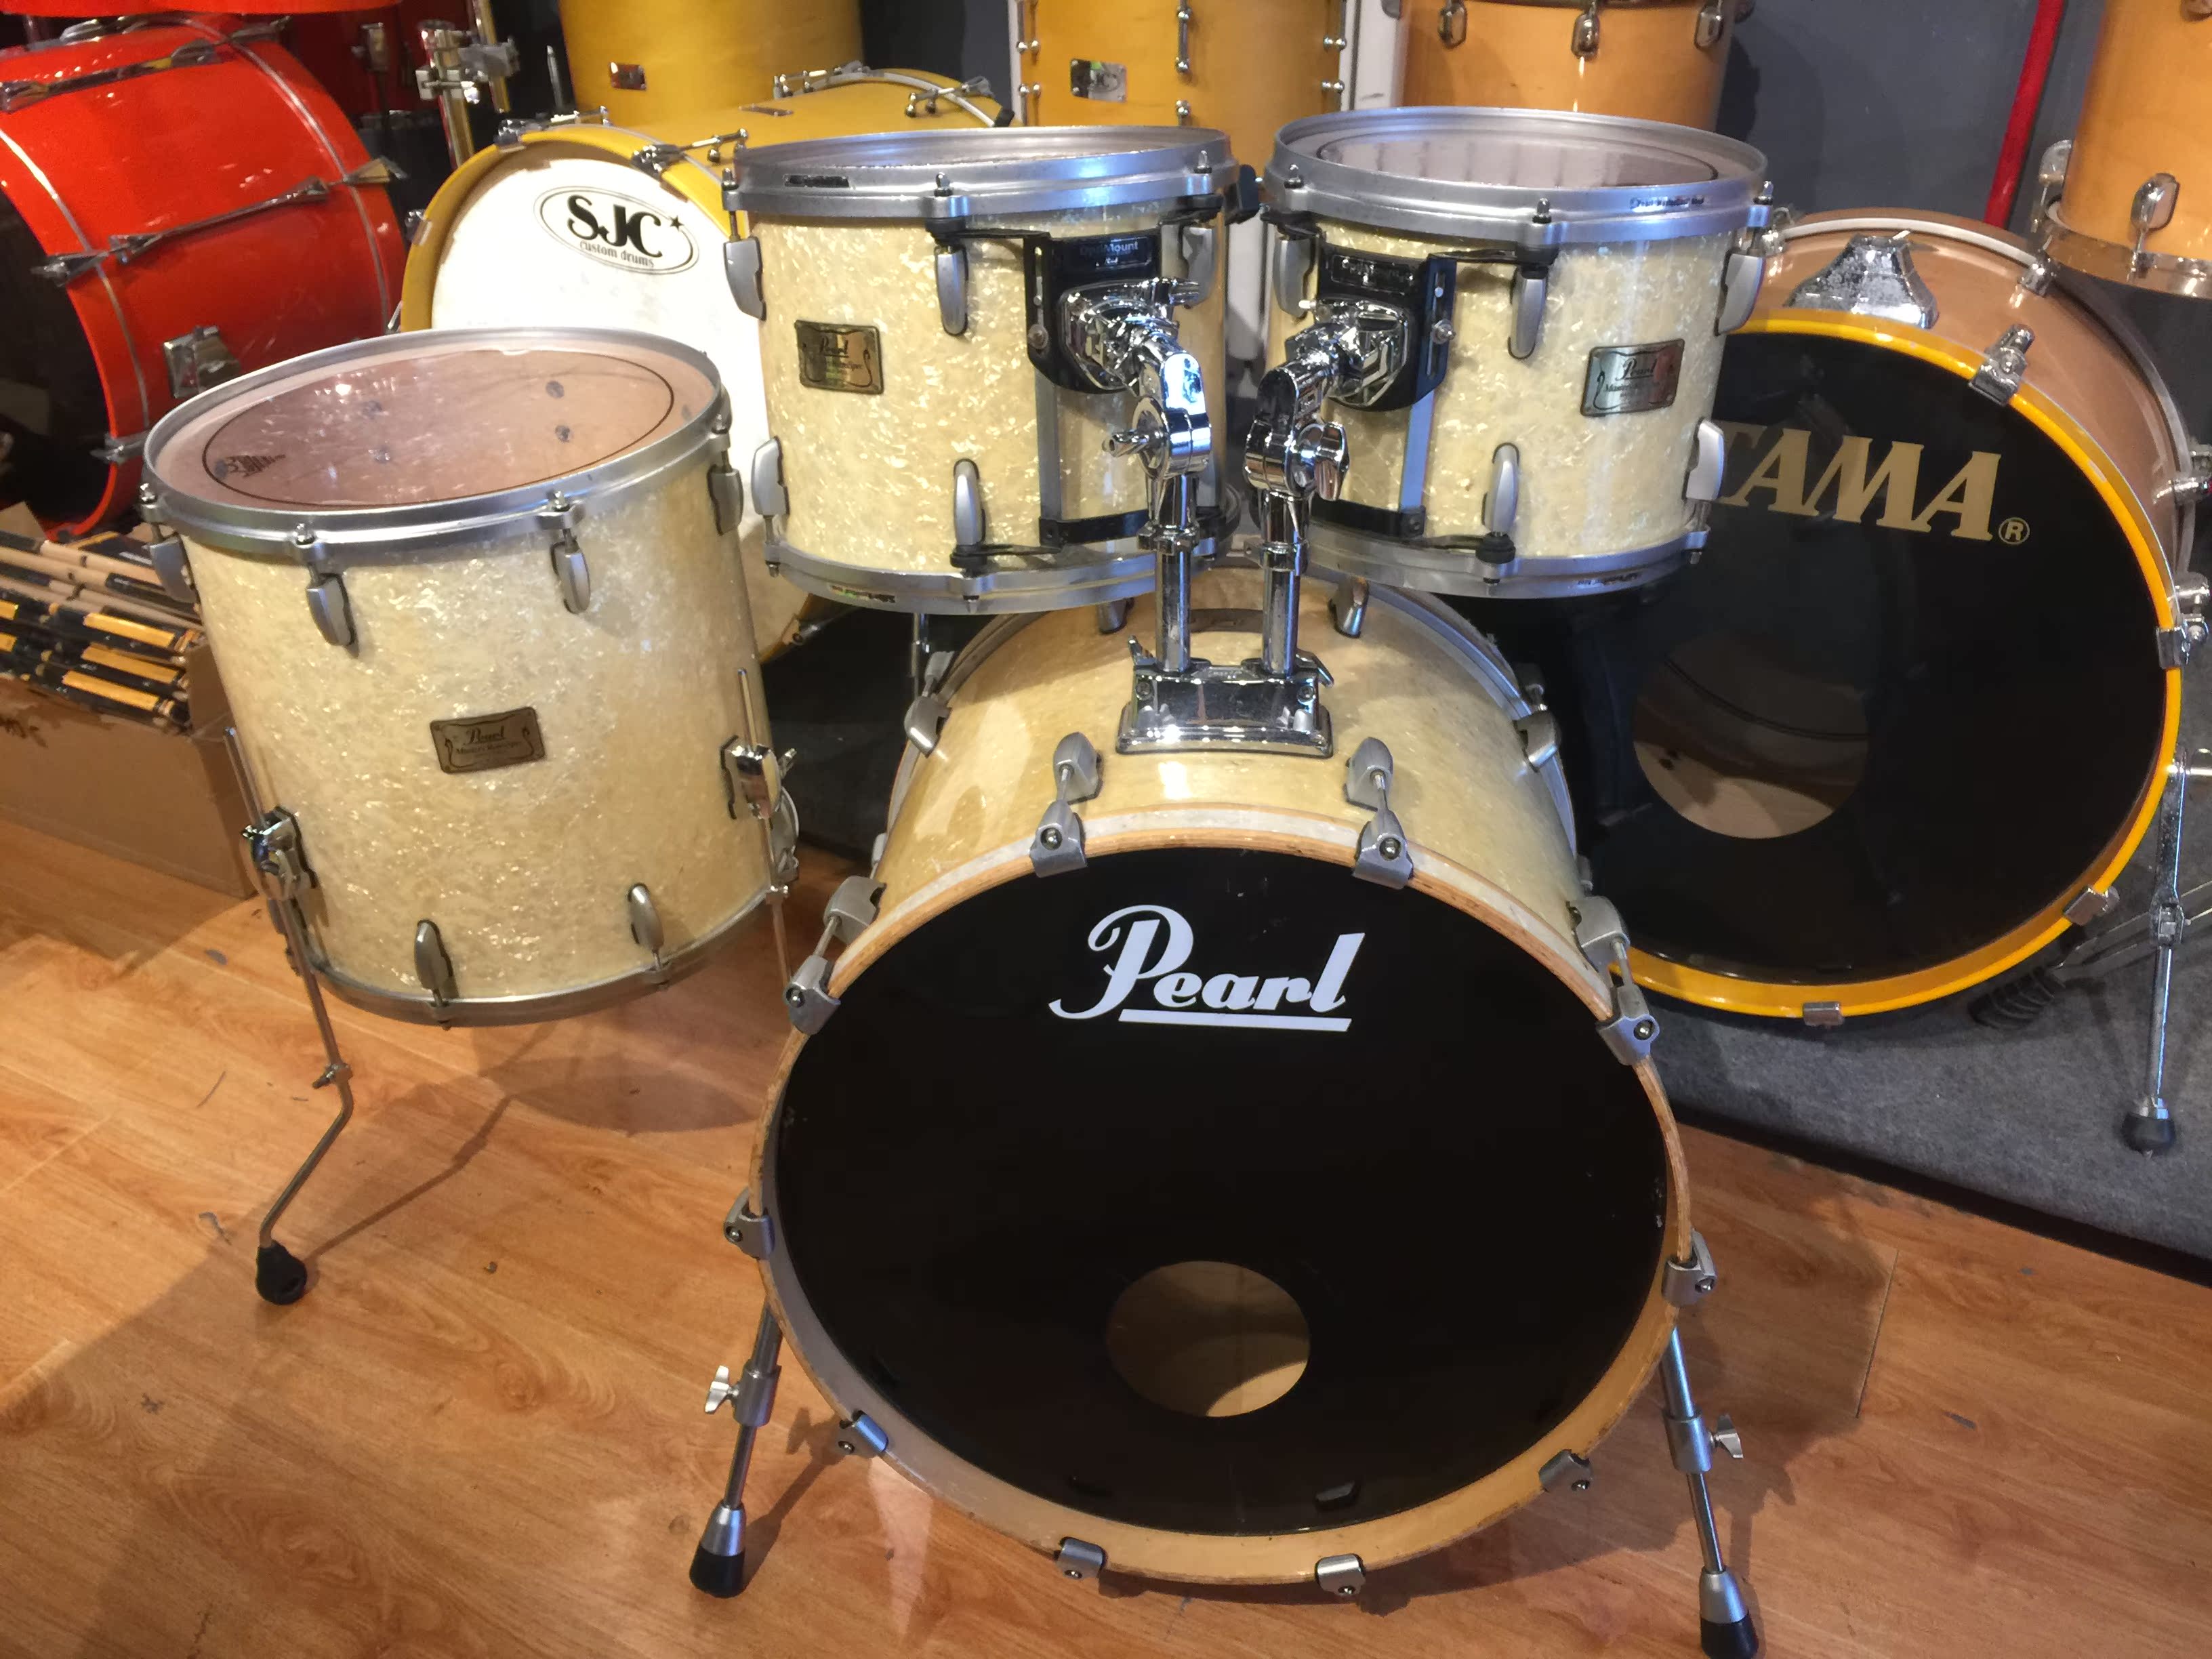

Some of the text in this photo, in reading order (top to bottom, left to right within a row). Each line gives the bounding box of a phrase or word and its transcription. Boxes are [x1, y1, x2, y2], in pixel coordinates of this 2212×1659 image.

[568, 194, 663, 258] SJC
[579, 241, 655, 268] custom drums
[1614, 358, 1658, 381] Pearl
[1048, 904, 1366, 1021] Pearl
